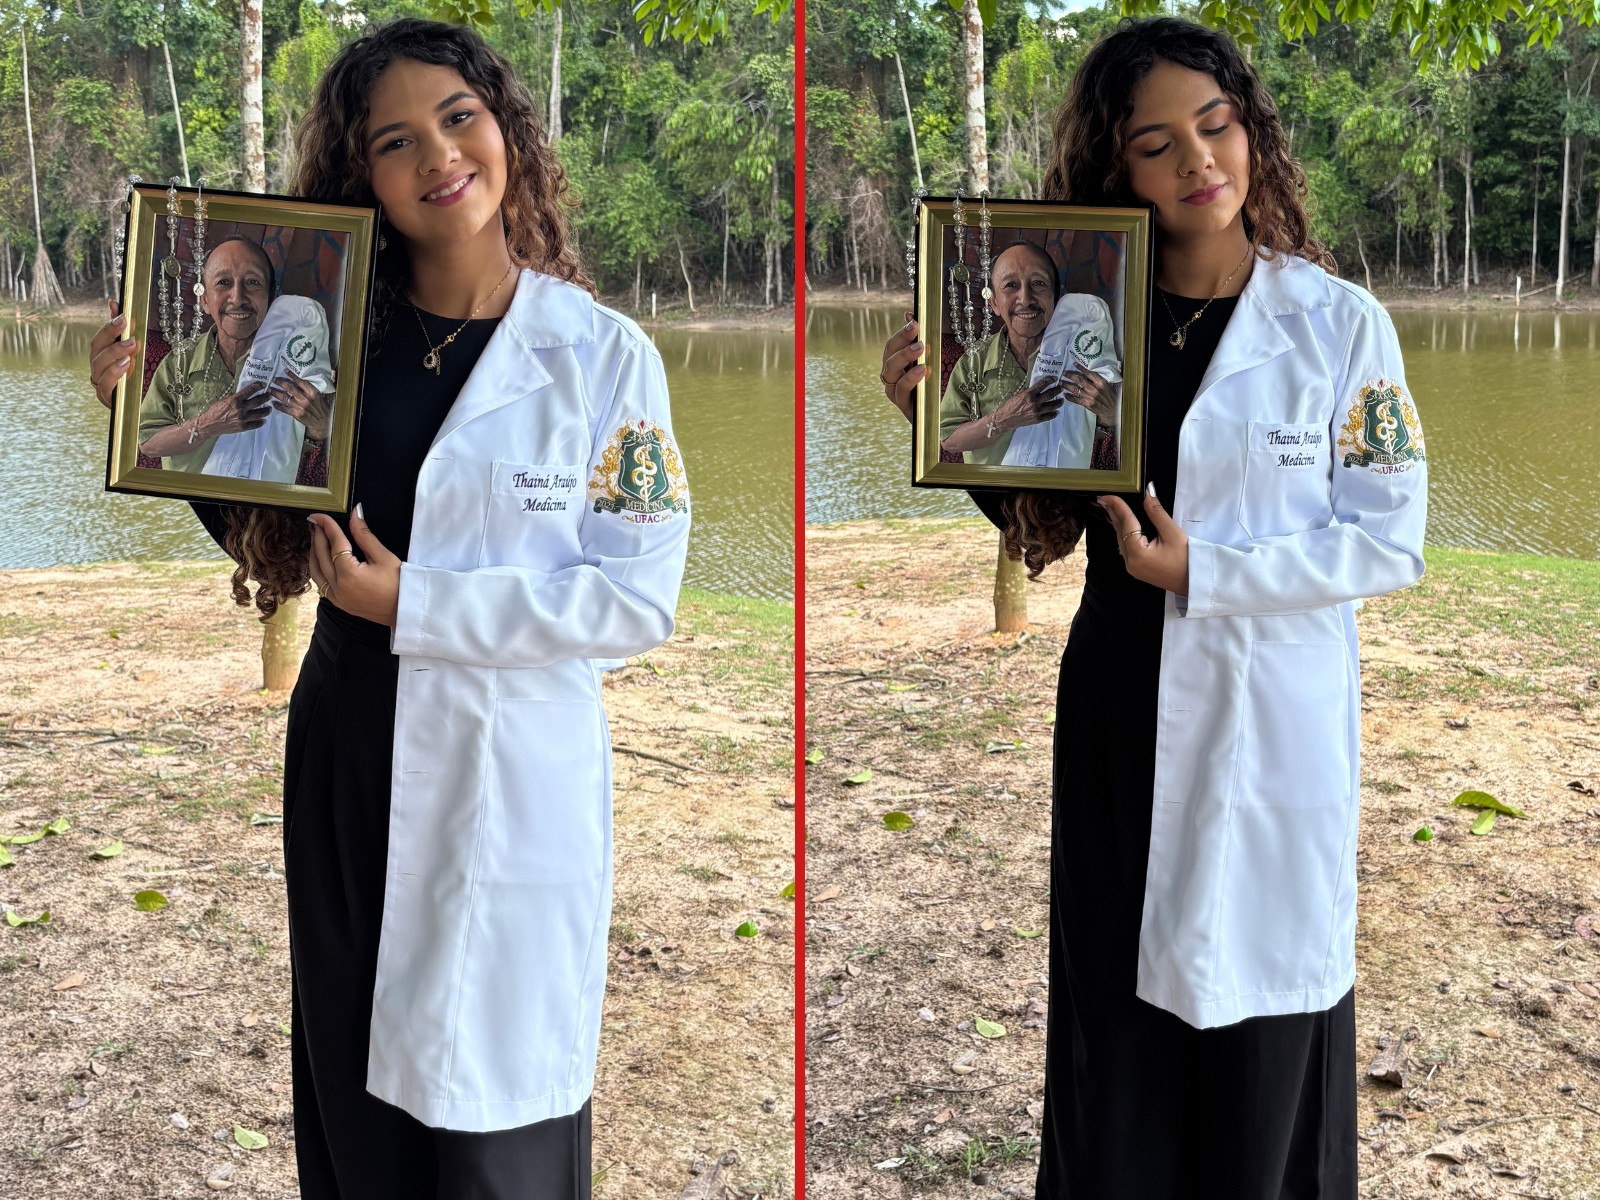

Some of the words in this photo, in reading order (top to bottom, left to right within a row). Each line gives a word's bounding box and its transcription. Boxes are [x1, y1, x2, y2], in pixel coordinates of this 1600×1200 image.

[1266, 430, 1301, 445] Thainá
[1277, 452, 1315, 467] Medicina
[1373, 451, 1408, 464] MEDICINA
[1382, 464, 1405, 475] UFAC
[513, 471, 551, 489] Thainá
[549, 474, 577, 493] Araújo
[522, 497, 566, 512] Medicina
[625, 499, 667, 512] MEDICINA
[635, 514, 660, 524] UFAC
